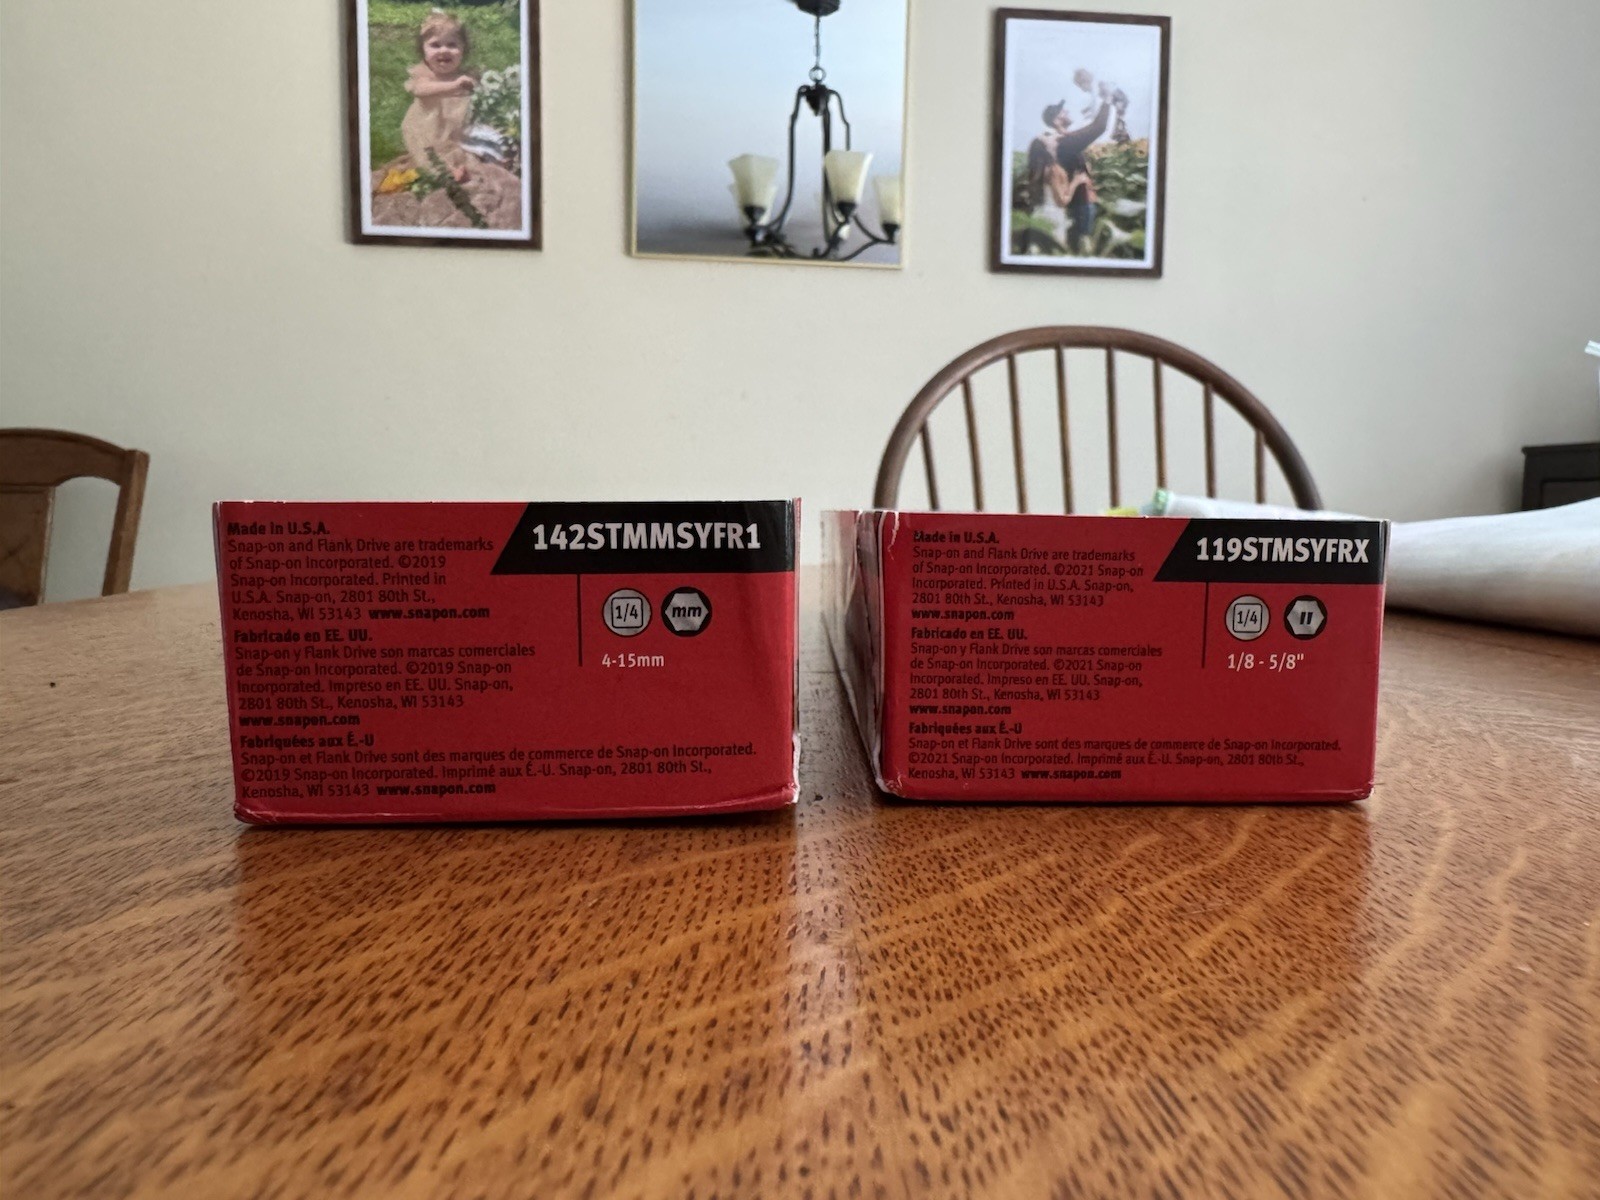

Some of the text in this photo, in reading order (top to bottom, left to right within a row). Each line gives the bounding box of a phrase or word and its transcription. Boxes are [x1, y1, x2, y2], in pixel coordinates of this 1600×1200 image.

[228, 523, 266, 533] Made
[270, 525, 284, 533] in
[532, 522, 761, 551] 142STMMSYFR1
[228, 540, 494, 553] Snap-on and Flank Drive are trademarks
[1196, 537, 1370, 563] 119STMSYFRX
[229, 558, 243, 568] of
[246, 557, 301, 570] Snap-on
[231, 575, 286, 587] Snap-on
[382, 574, 432, 584] Printed
[432, 576, 446, 584] in
[340, 592, 374, 602] 2801
[378, 591, 409, 601] 80th
[298, 608, 314, 618] WI
[319, 608, 361, 618] 53143
[368, 609, 490, 620] www.snapon.com
[615, 604, 702, 622] 1/4 mm
[1236, 609, 1258, 626] 1/4
[234, 631, 300, 641] Fabricado
[304, 632, 321, 640] en
[235, 645, 535, 661] Snap-on y Flank Drive son marcas comerciales
[601, 653, 665, 668] 4-15mm
[1227, 653, 1254, 672] 1/8
[1269, 653, 1305, 673] 5/8"
[236, 665, 252, 675] de
[256, 664, 311, 677] Snap-on
[457, 662, 512, 675] Snap-on
[328, 681, 382, 694] Impreso
[384, 683, 401, 691] en
[239, 698, 272, 708] 2801
[276, 697, 307, 707] 80th
[400, 696, 417, 706] WI
[422, 696, 464, 706] 53143
[239, 715, 360, 727] www.snapon.com
[240, 735, 315, 749] Fabriquées
[319, 738, 344, 746] aux
[241, 752, 296, 766] Snap-on
[299, 752, 312, 762] et
[316, 751, 351, 762] Flank
[354, 751, 387, 761] Drive
[391, 750, 419, 760] sont
[422, 750, 445, 760] des
[449, 750, 505, 762] marques
[508, 748, 525, 758] de
[528, 749, 594, 758] commerce
[596, 746, 613, 756] de
[616, 745, 670, 759] Snap-on
[294, 768, 348, 782] Snap-on
[442, 764, 495, 779] Imprimé
[498, 767, 524, 775] aux
[621, 763, 653, 773] 2801
[657, 762, 687, 772] 80th
[307, 785, 323, 795] WI
[328, 785, 369, 795] 53143
[376, 784, 496, 796] www.snapon.com
